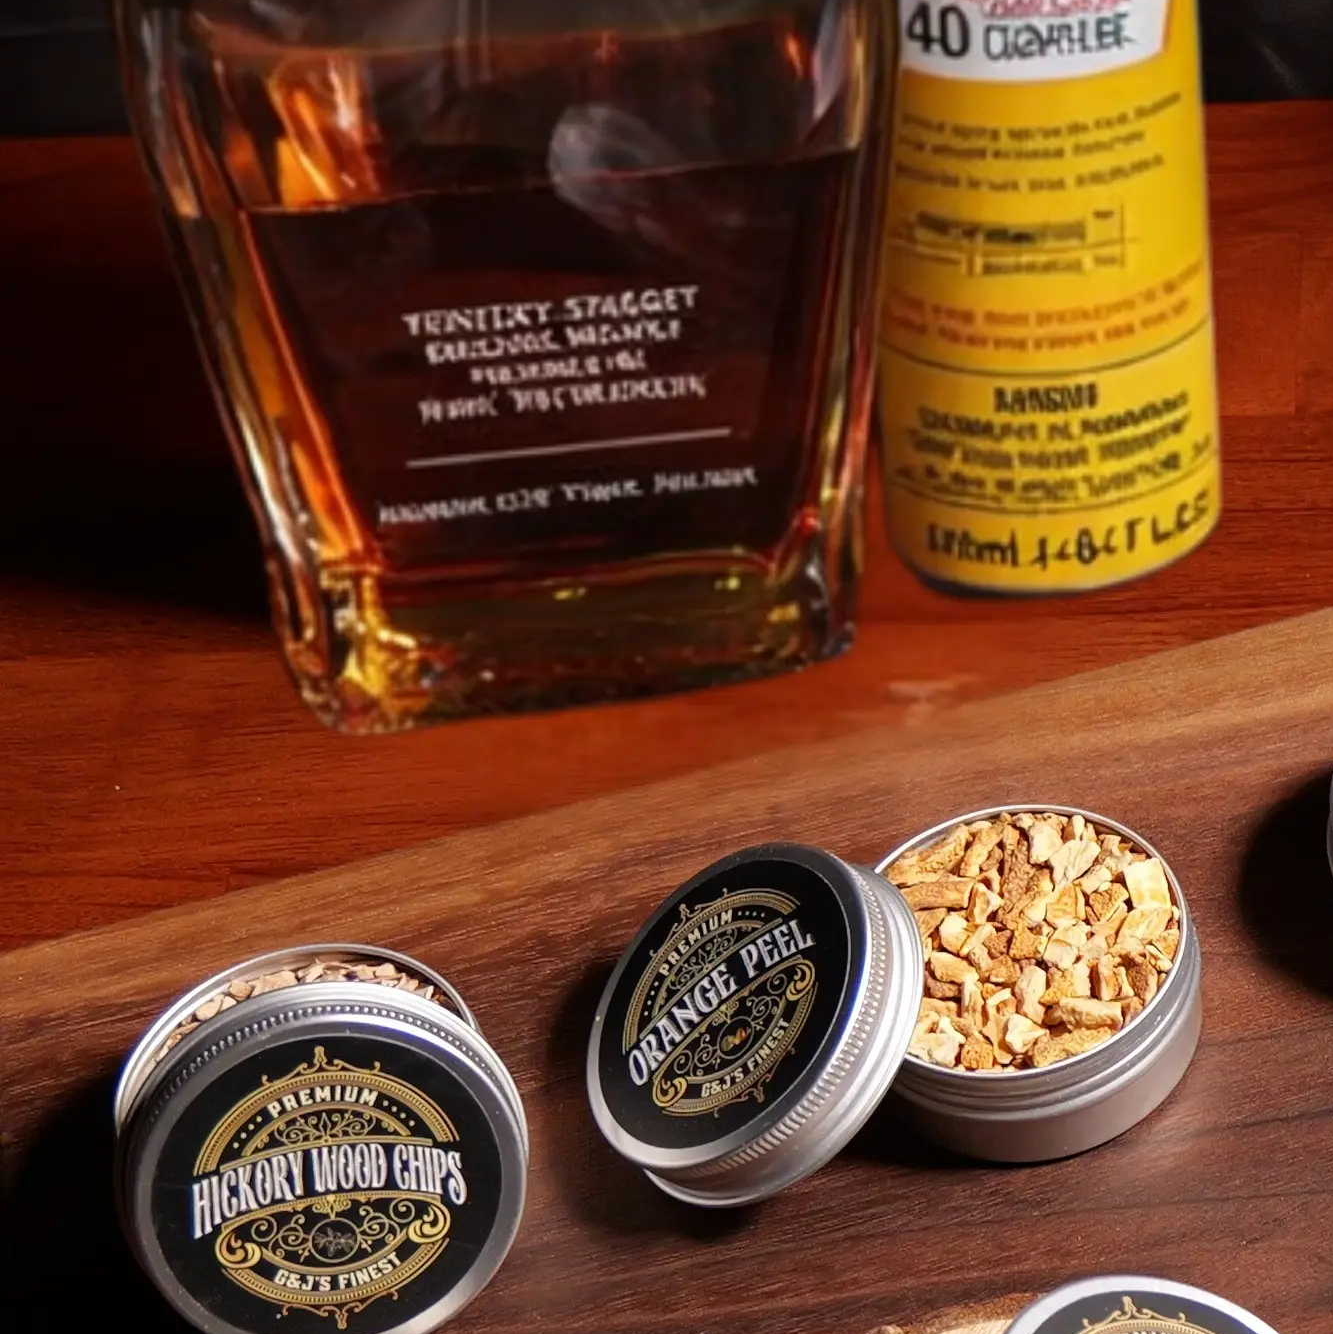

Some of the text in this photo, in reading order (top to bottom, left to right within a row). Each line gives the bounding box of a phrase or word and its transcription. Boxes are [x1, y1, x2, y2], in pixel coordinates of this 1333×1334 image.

[905, 0, 971, 58] 40
[658, 908, 733, 977] PREMIUM
[628, 918, 816, 1087] ORANGE PEEL
[700, 1018, 791, 1099] G&J'S FINEST
[268, 1084, 379, 1119] PREMIUM
[191, 1142, 468, 1240] HICKORY WOOD CHIPS
[272, 1251, 402, 1292] G&J'S FINEST
